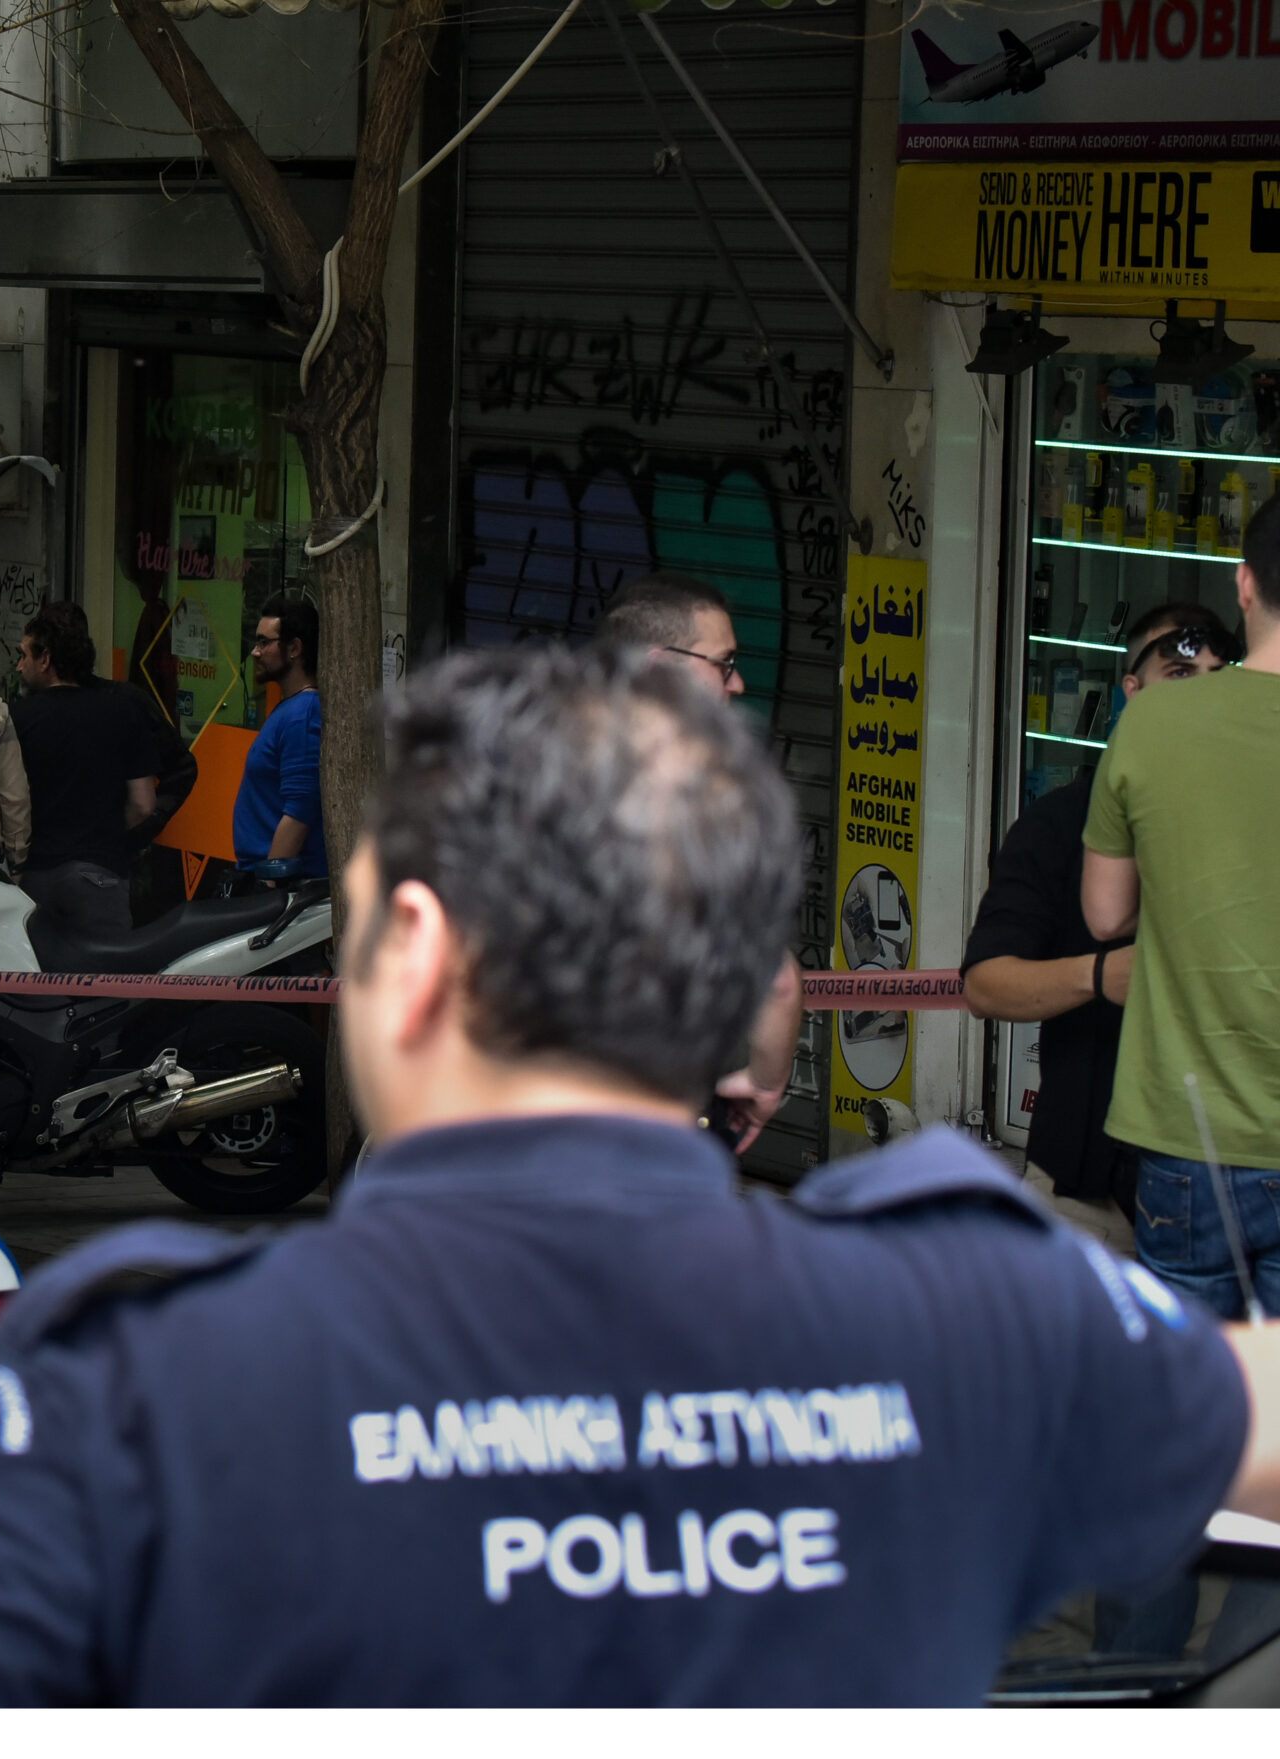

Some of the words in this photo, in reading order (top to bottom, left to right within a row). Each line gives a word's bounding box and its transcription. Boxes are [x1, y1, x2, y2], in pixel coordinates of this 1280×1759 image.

[906, 135, 970, 150] ΑΕΡΟΠΟΡΙΚΑ
[973, 135, 1019, 149] ΕΙΣΙΤΗΡΙΑ
[1028, 135, 1076, 149] ΕΙΣΙΤΗΡΙΑ
[1079, 134, 1149, 149] ΛΕΩΦΟΡΕΙΟΥ
[1159, 134, 1227, 149] ΑΕΡΟΠΟΡΙΚΑ
[979, 172, 1017, 206] SEND
[1021, 174, 1031, 206] &
[1036, 172, 1094, 206] RECEIVE
[1099, 171, 1212, 269] HERE
[974, 210, 1092, 282] MONEY
[1099, 270, 1144, 285] WITHIN
[1150, 271, 1209, 286] MINUTES
[847, 772, 916, 802] AFGHAN
[851, 798, 911, 827] MOBILE
[846, 823, 913, 853] SERVICE
[857, 980, 867, 995] Η
[868, 979, 965, 996] ΑΠΑΓΟΡΕΥΕΤΑΙ
[349, 1393, 627, 1483] ΕΛΛΗΝΙΚΗ
[482, 1506, 847, 1603] POLICE
